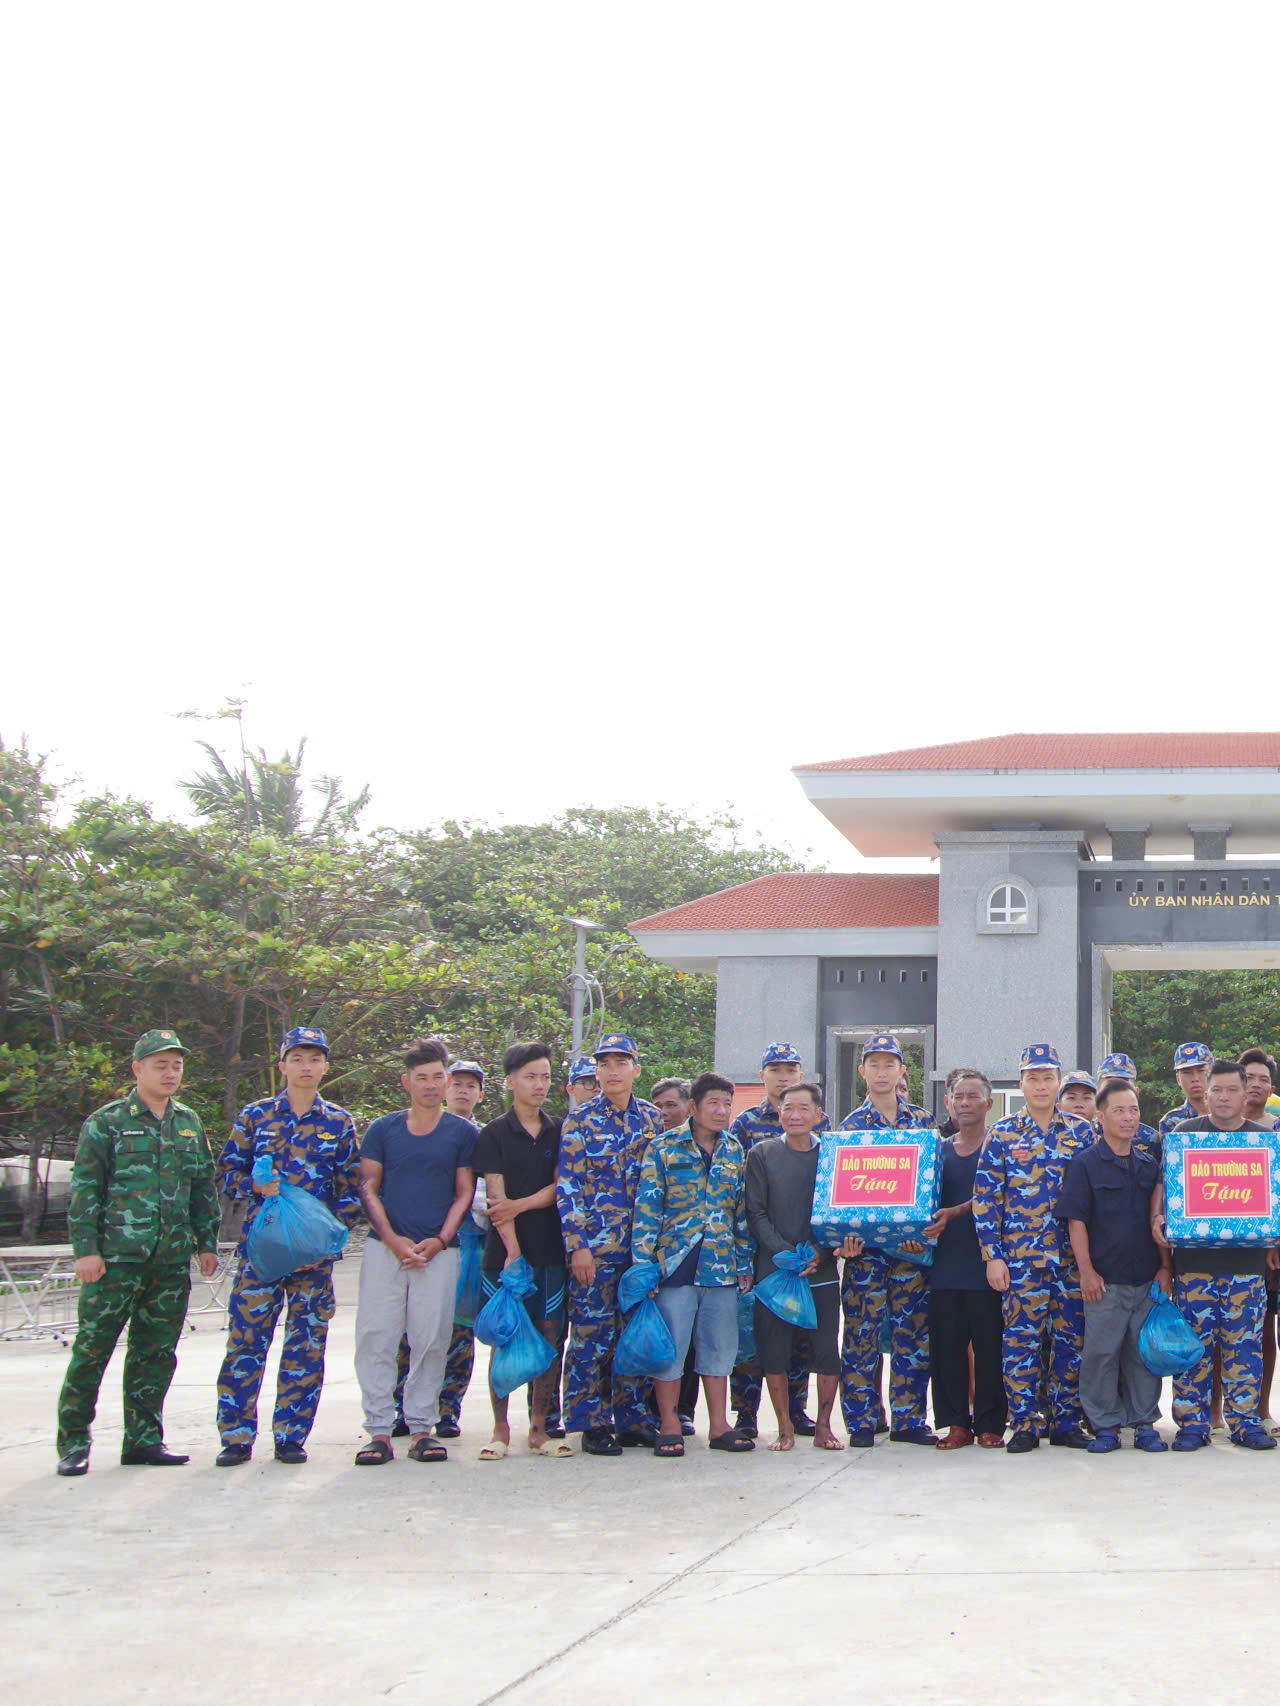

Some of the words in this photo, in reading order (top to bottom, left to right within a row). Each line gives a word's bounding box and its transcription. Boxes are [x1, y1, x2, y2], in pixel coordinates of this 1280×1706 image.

[1128, 891, 1150, 907] ỦY
[1155, 895, 1187, 907] BAN
[1191, 891, 1234, 906] NHÂN
[1238, 891, 1270, 906] DÂN
[841, 1154, 860, 1171] ĐẢO
[862, 1154, 897, 1170] TRƯỜNG
[898, 1157, 911, 1169] SA
[1191, 1160, 1210, 1177] ĐẢO
[1212, 1160, 1249, 1176] TRƯỜNG
[1250, 1163, 1263, 1176] SA
[849, 1174, 898, 1194] Tặng
[1202, 1182, 1252, 1204] Tặng
